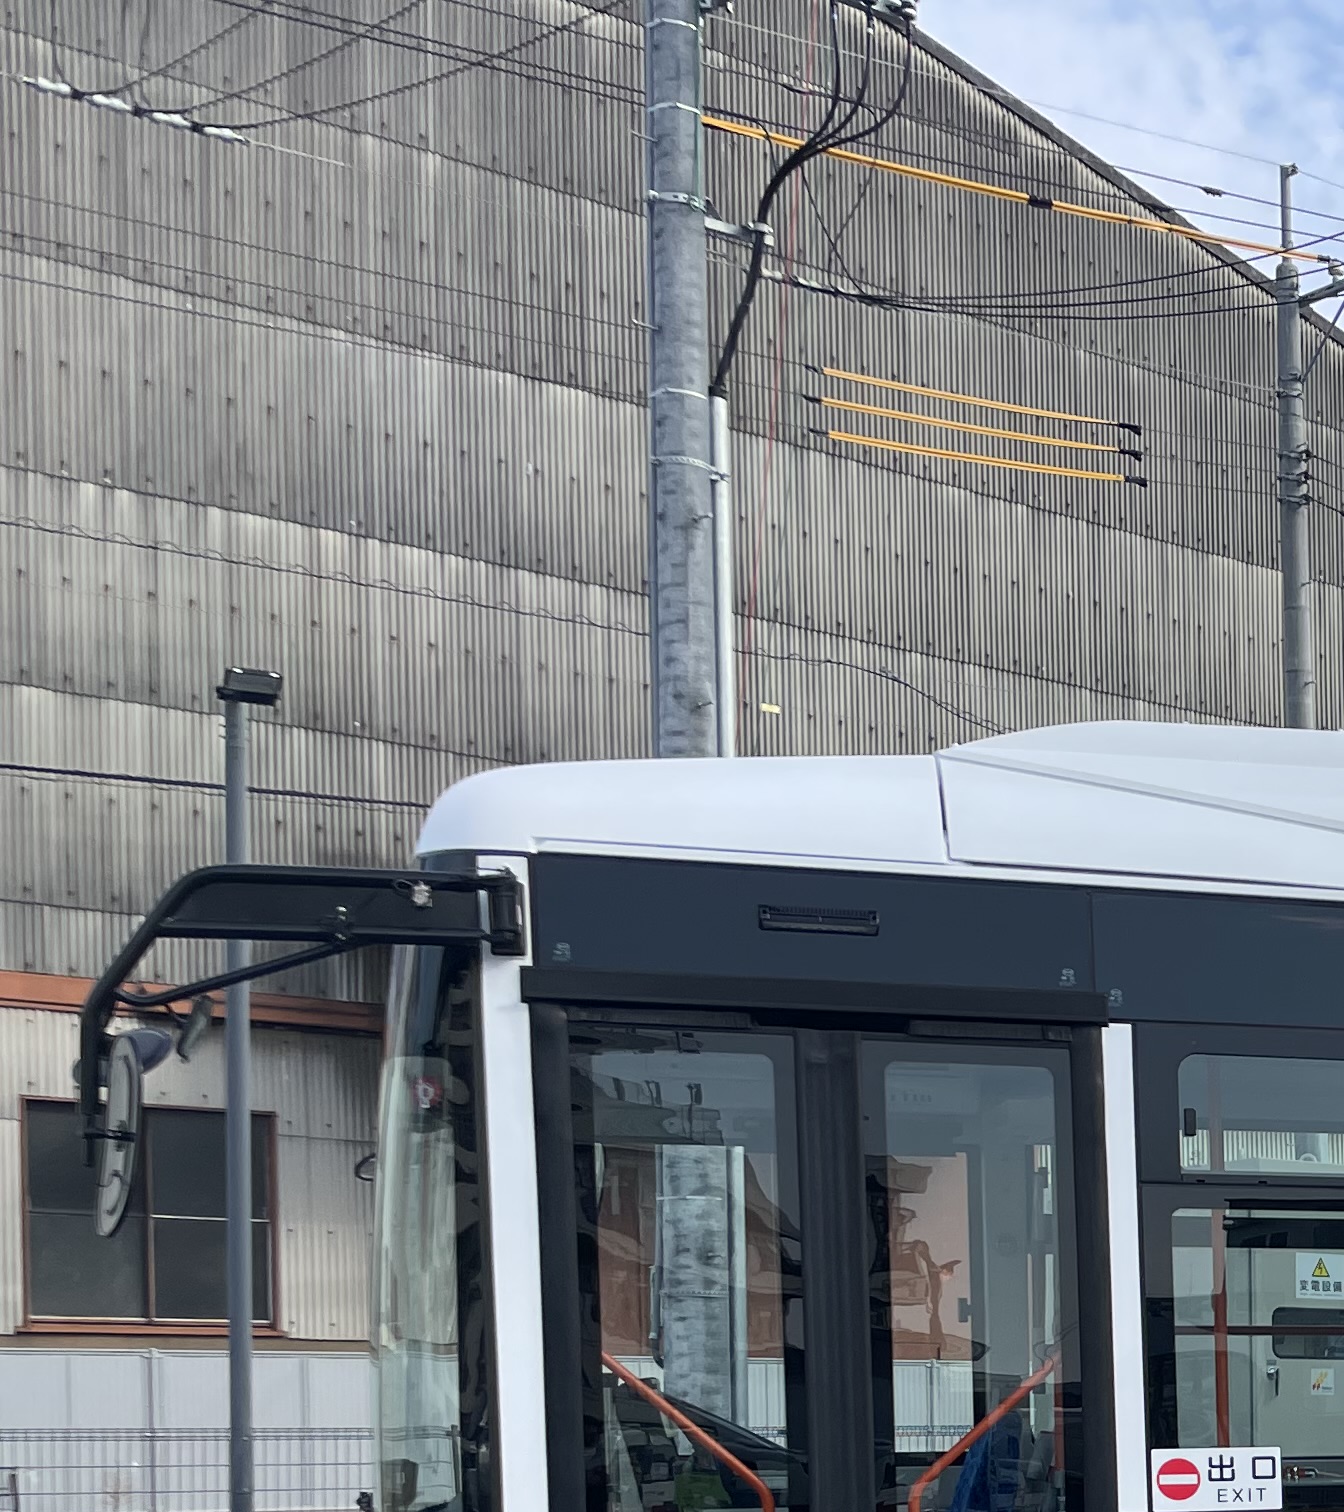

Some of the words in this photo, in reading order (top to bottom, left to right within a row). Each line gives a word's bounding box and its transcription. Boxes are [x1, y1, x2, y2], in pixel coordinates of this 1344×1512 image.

[1299, 1280, 1343, 1293] 変電設備
[1207, 1454, 1277, 1482] 出口
[1217, 1487, 1268, 1503] EXIT
